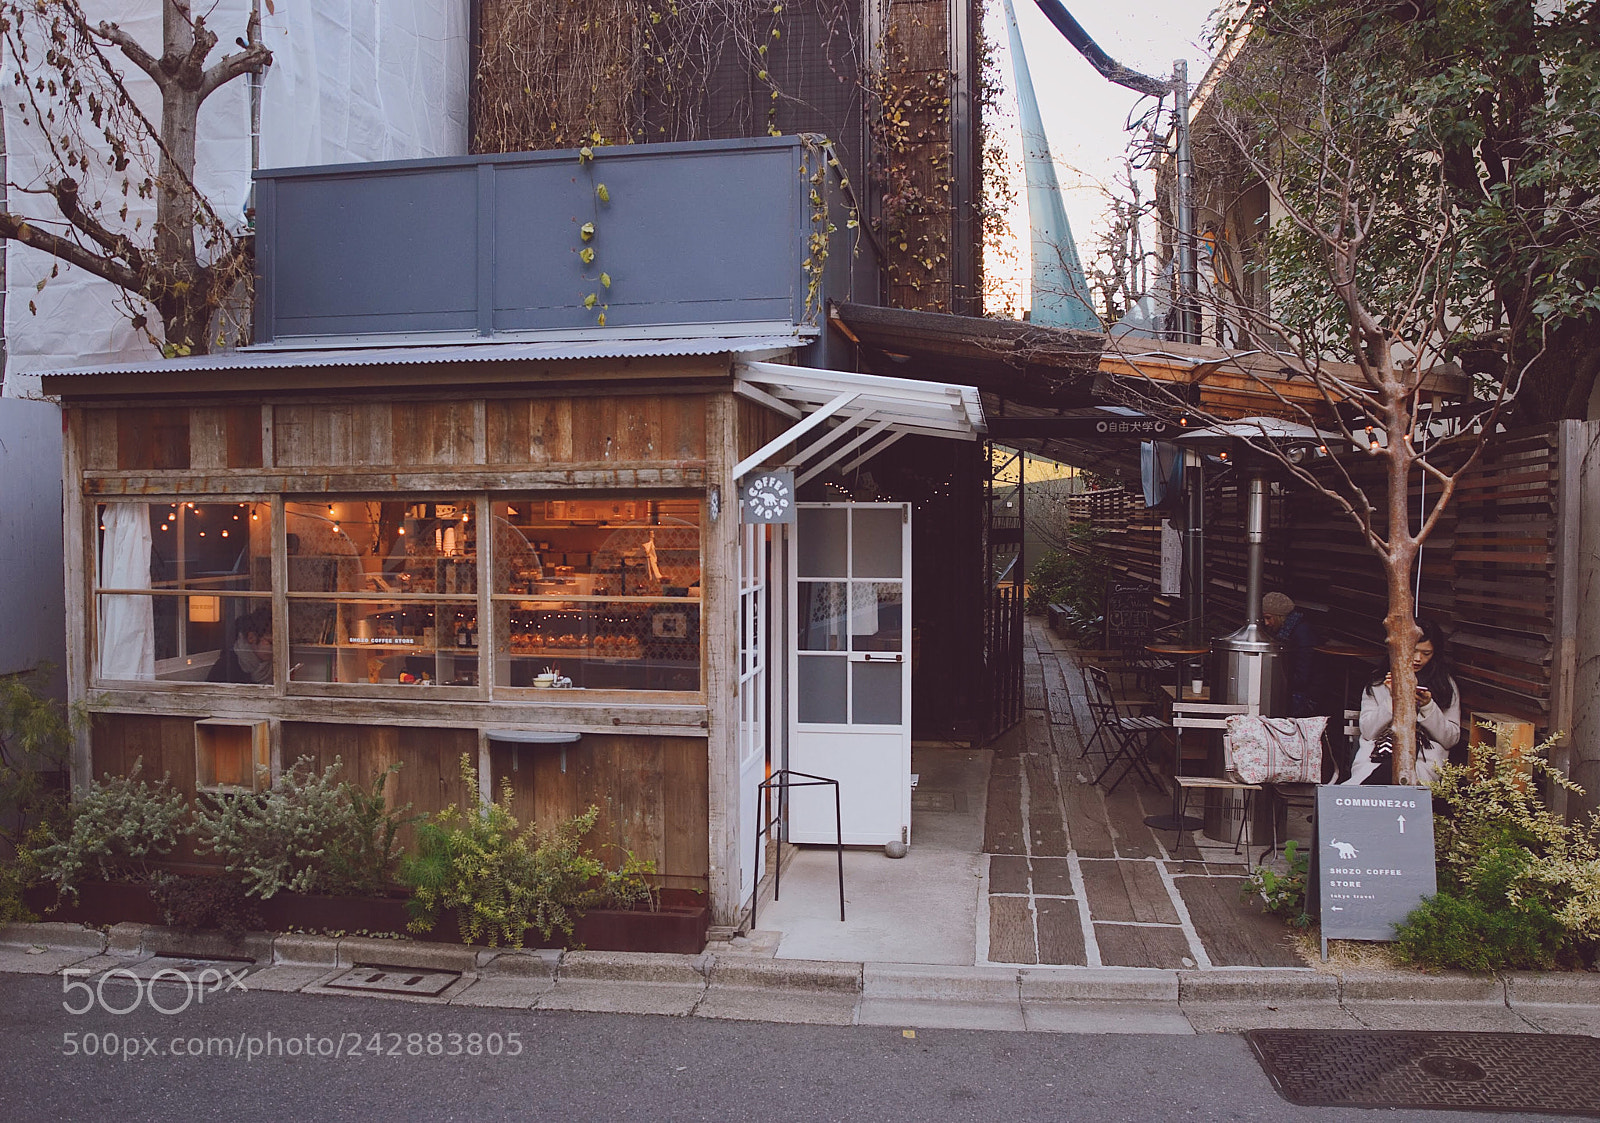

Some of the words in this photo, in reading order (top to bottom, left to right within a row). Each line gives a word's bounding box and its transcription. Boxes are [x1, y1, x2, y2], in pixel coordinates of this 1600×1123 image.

[748, 476, 789, 497] COFFEE
[749, 498, 789, 520] SHOZO
[1335, 798, 1416, 809] COMMUNE246
[1366, 868, 1402, 876] COFFEE
[1330, 880, 1362, 888] STORE
